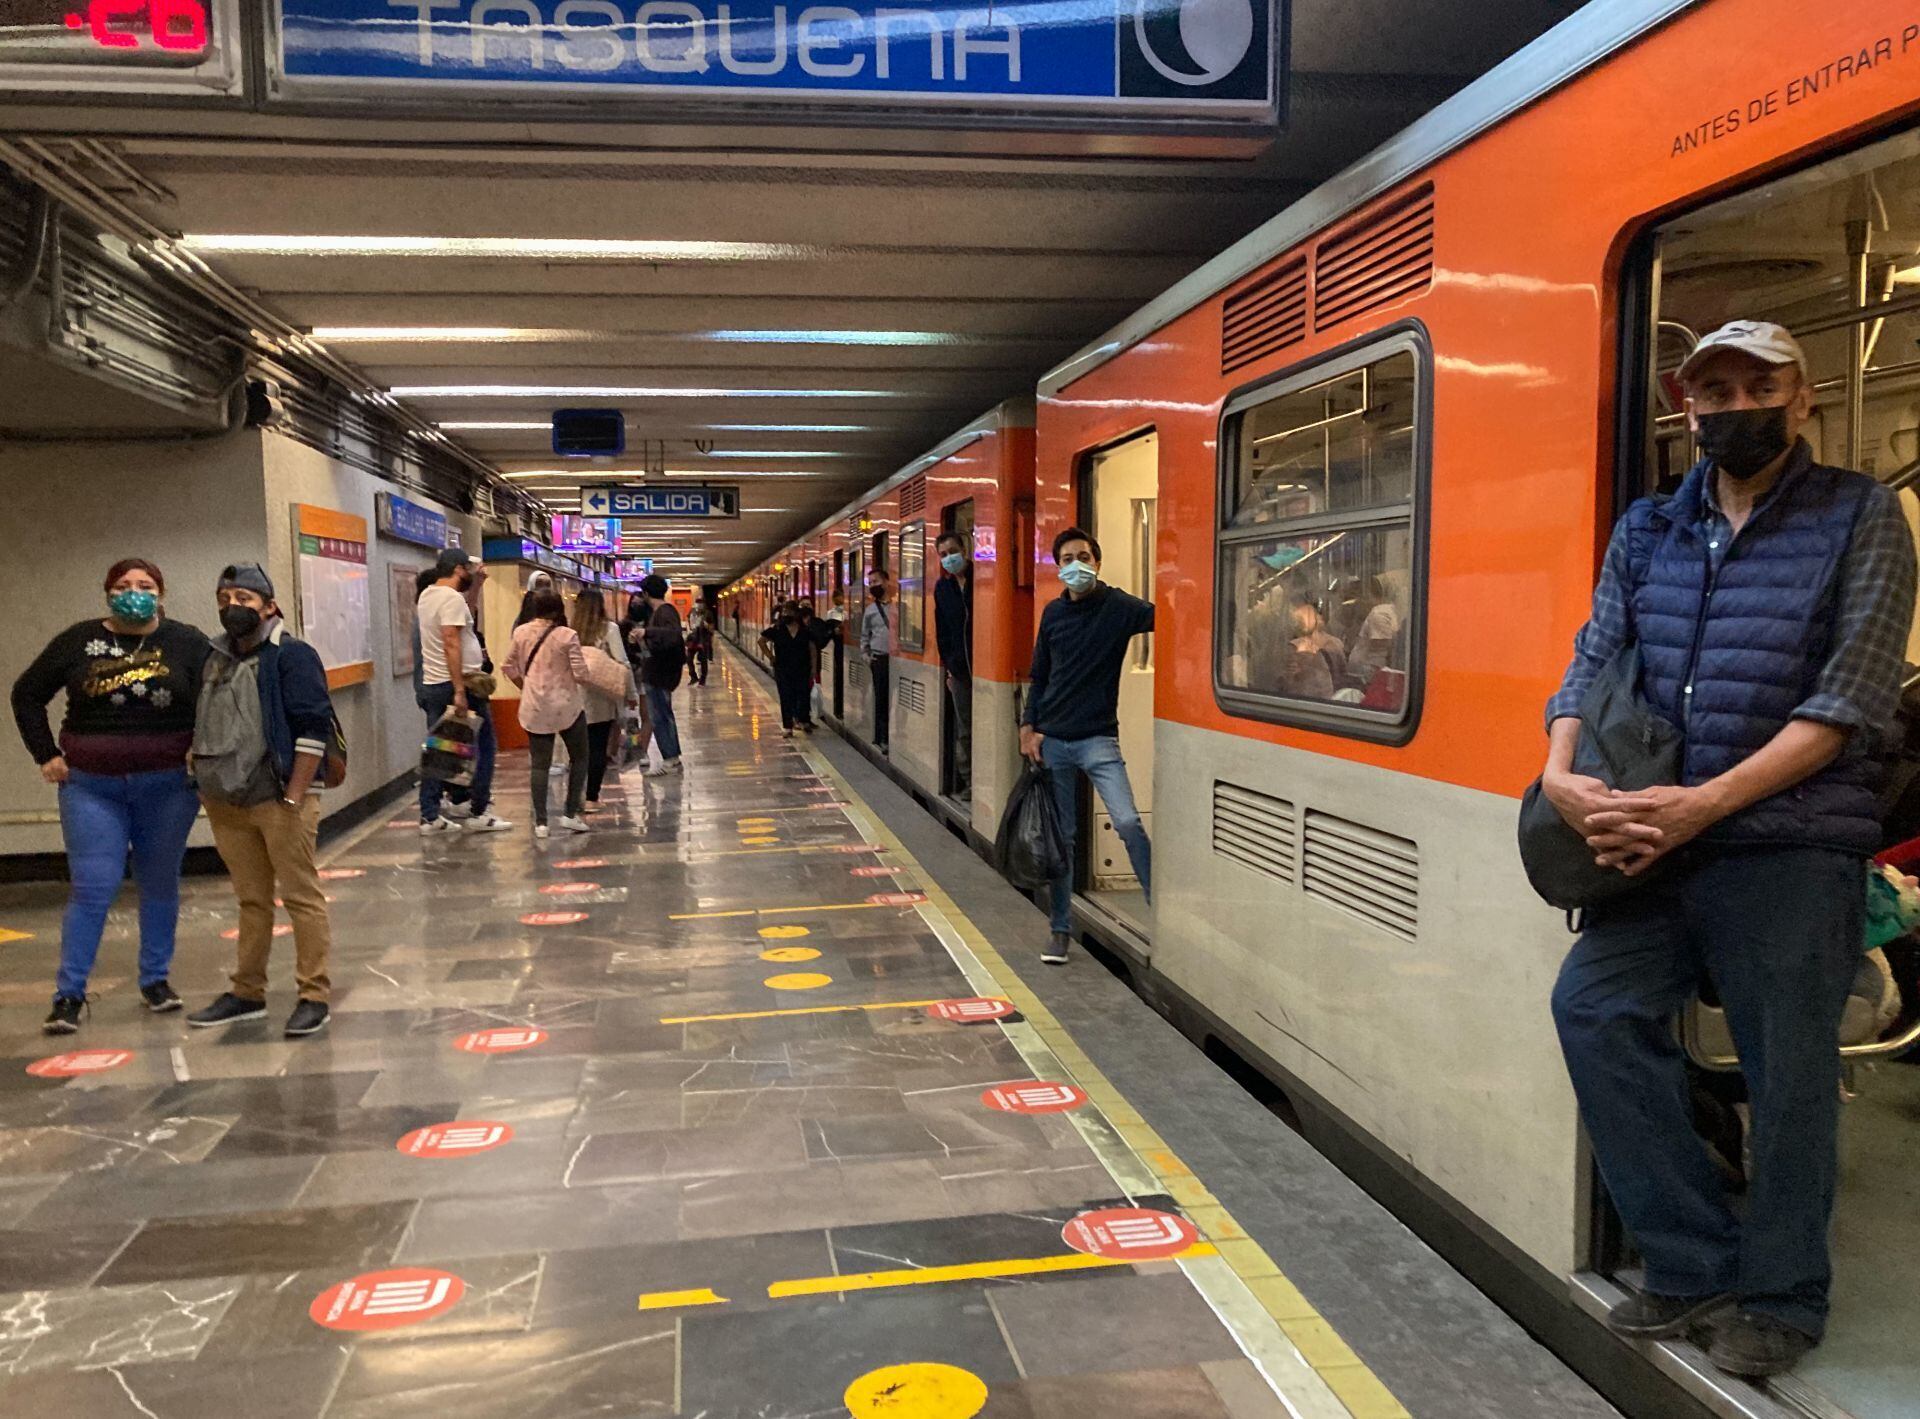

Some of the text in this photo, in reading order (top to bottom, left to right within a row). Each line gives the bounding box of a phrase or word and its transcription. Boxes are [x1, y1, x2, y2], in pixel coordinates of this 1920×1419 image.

[1671, 109, 1740, 157] ANTES
[1748, 90, 1778, 123] DE
[1786, 37, 1892, 105] ENTRAR
[614, 494, 704, 510] SALIDA
